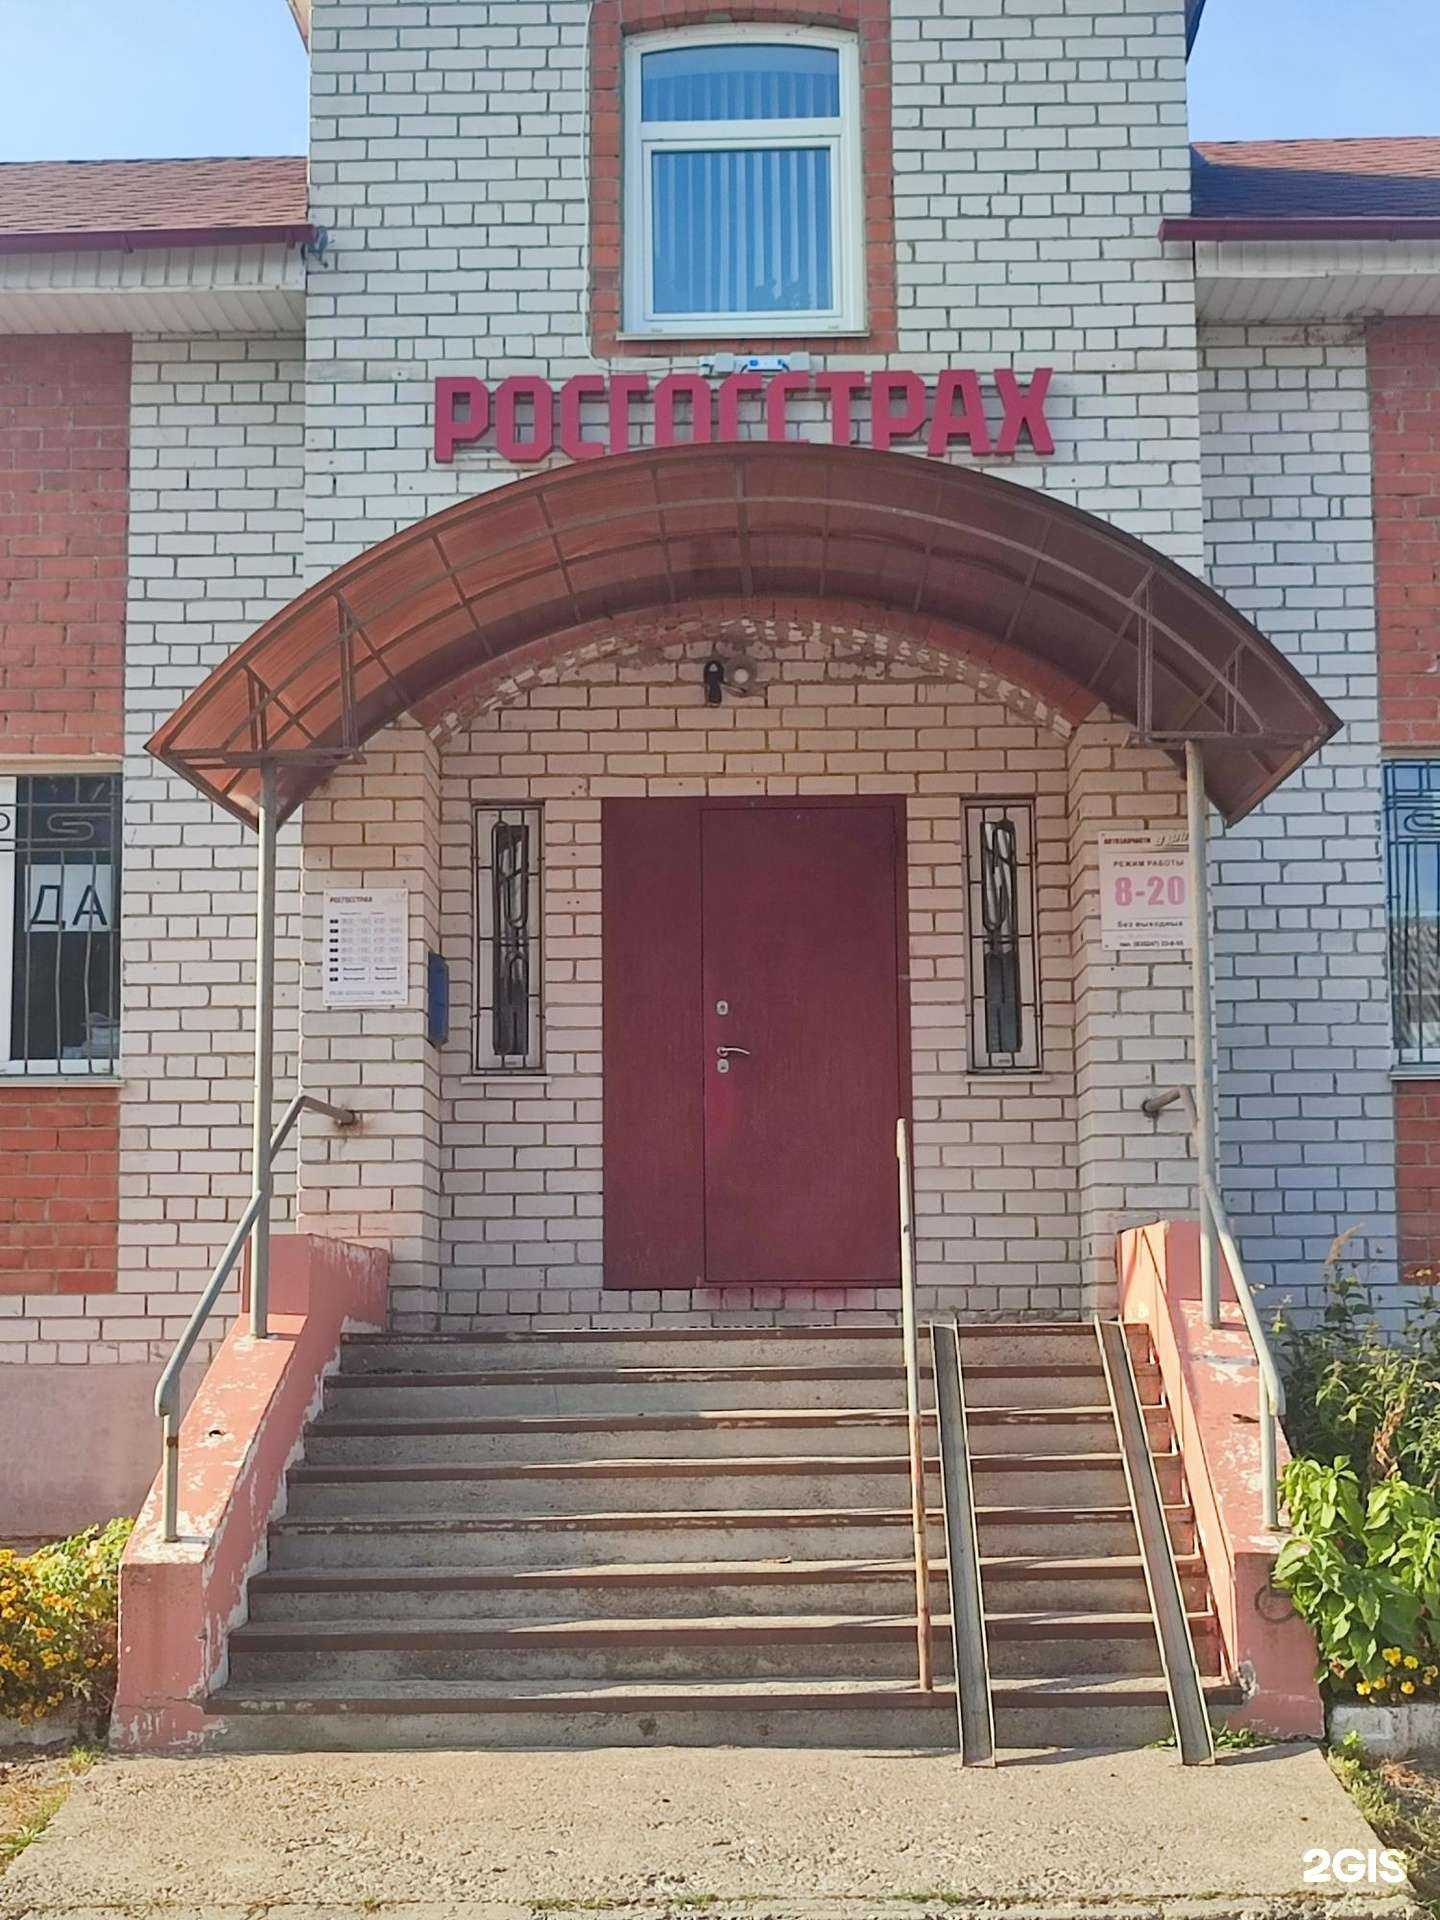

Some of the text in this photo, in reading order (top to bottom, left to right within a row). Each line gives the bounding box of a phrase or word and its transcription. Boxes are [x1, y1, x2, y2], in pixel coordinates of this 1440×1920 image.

[434, 367, 1055, 463] РОСГОССТРАХ
[1113, 858, 1184, 868] РЕЖИМ РАБОТЫ
[1114, 875, 1185, 907] 8-20
